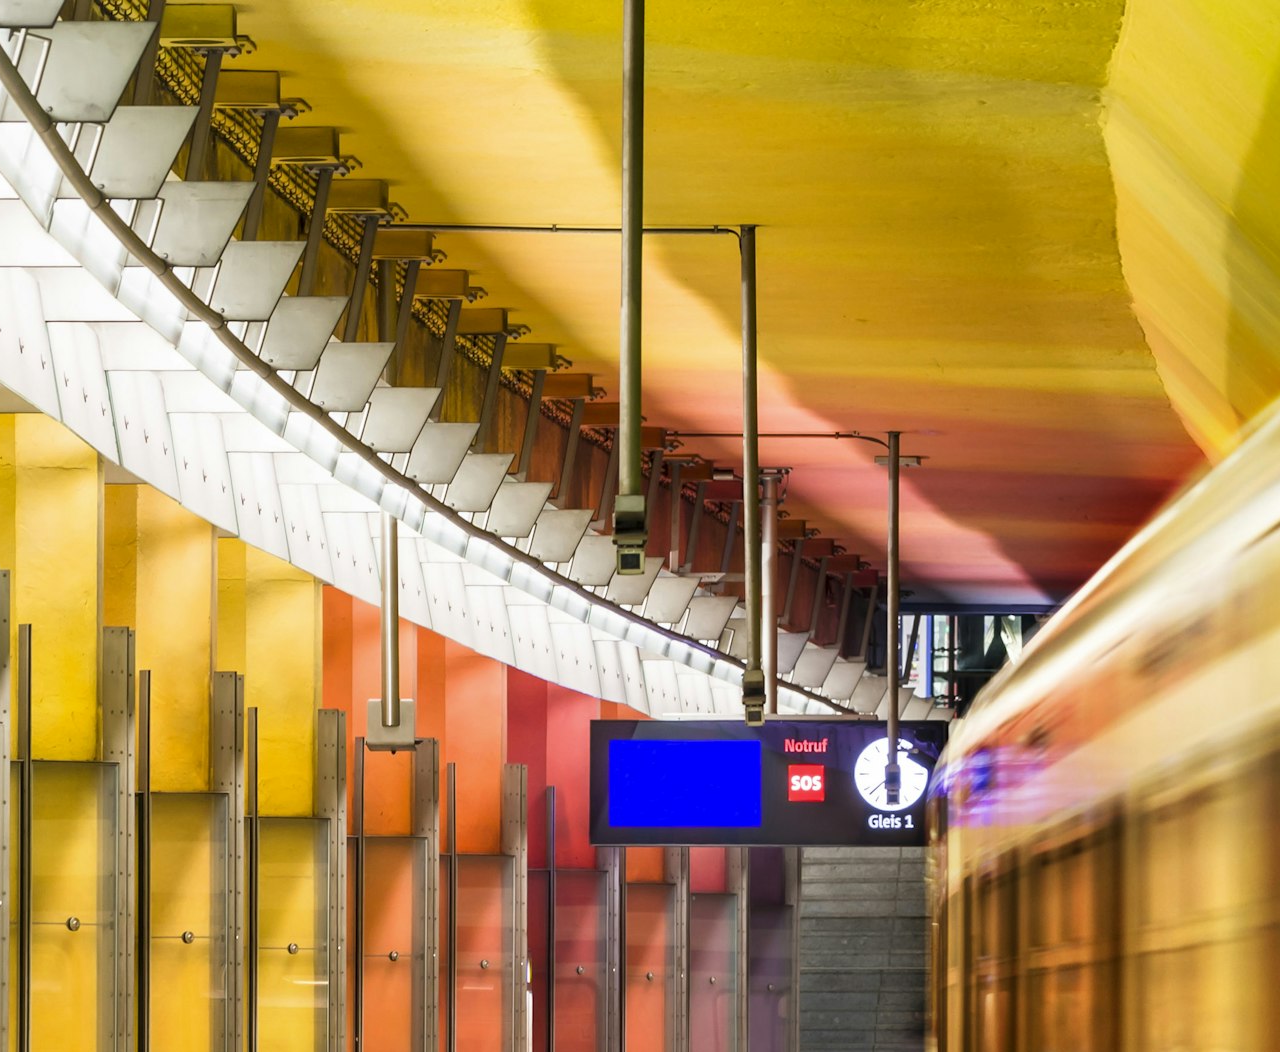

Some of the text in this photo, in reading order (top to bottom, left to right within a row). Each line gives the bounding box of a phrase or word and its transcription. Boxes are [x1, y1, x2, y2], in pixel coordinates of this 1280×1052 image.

[784, 738, 828, 753] Notruf
[791, 775, 822, 791] SOS
[868, 814, 914, 829] Gleis 1
